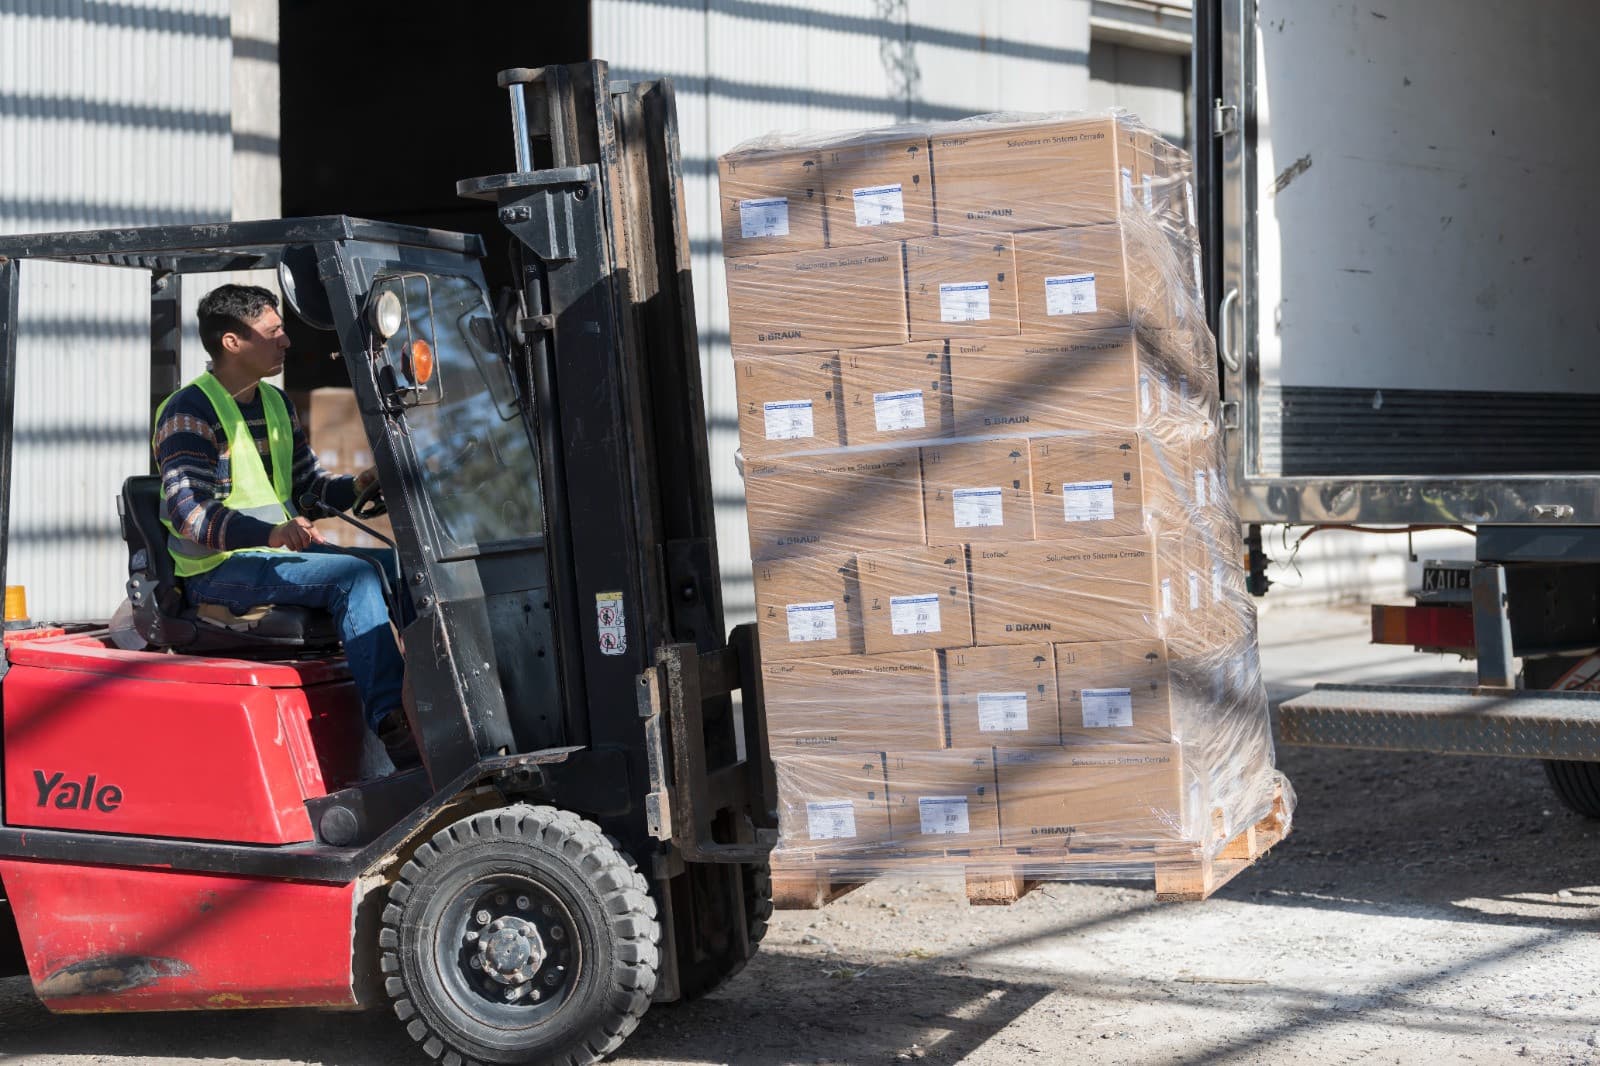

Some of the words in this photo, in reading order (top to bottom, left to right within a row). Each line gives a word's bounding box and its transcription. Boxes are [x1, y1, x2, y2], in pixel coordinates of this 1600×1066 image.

[1007, 139, 1041, 148] Soluciones
[1052, 135, 1077, 143] Sistema
[1079, 131, 1105, 141] Cerrado
[864, 255, 889, 263] Cerrado
[857, 463, 881, 471] Sistema
[1093, 552, 1118, 560] Sistema
[1016, 623, 1051, 632] BRAUN
[1144, 756, 1170, 764] Cerrado
[33, 770, 123, 812] Yale
[1041, 826, 1076, 835] BRAUN
